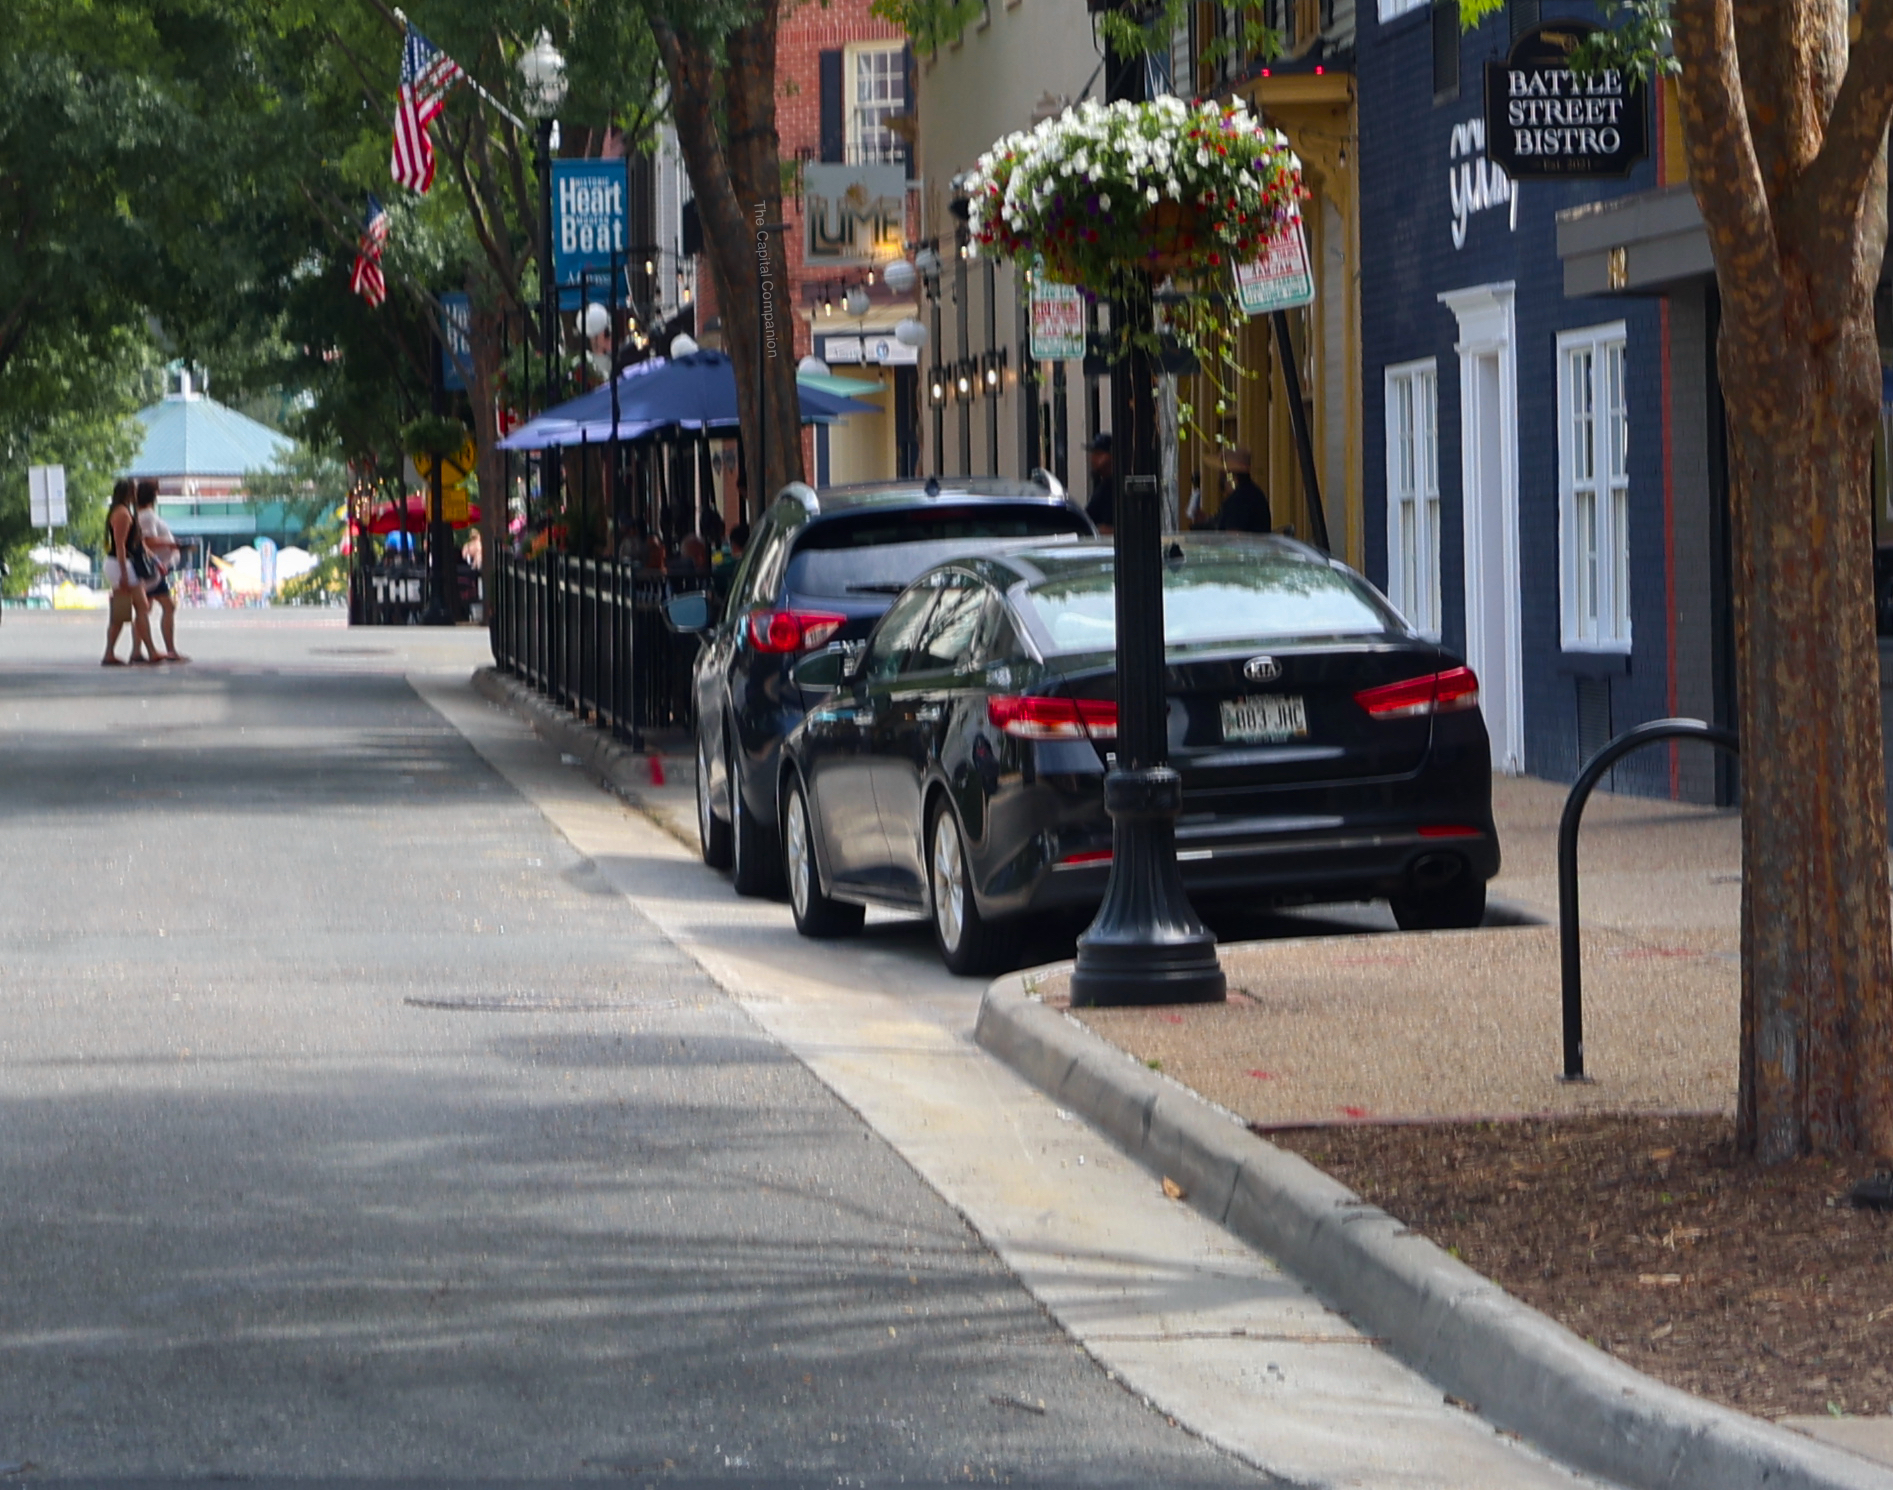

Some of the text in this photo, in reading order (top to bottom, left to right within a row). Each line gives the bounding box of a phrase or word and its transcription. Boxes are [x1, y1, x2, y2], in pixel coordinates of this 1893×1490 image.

[1508, 68, 1622, 97] BATTLE
[1508, 98, 1623, 126] STREET
[1514, 126, 1621, 155] BISTRO
[559, 176, 623, 216] Heart
[561, 214, 624, 254] Beat
[372, 576, 421, 604] THE
[1250, 662, 1277, 678] KIA
